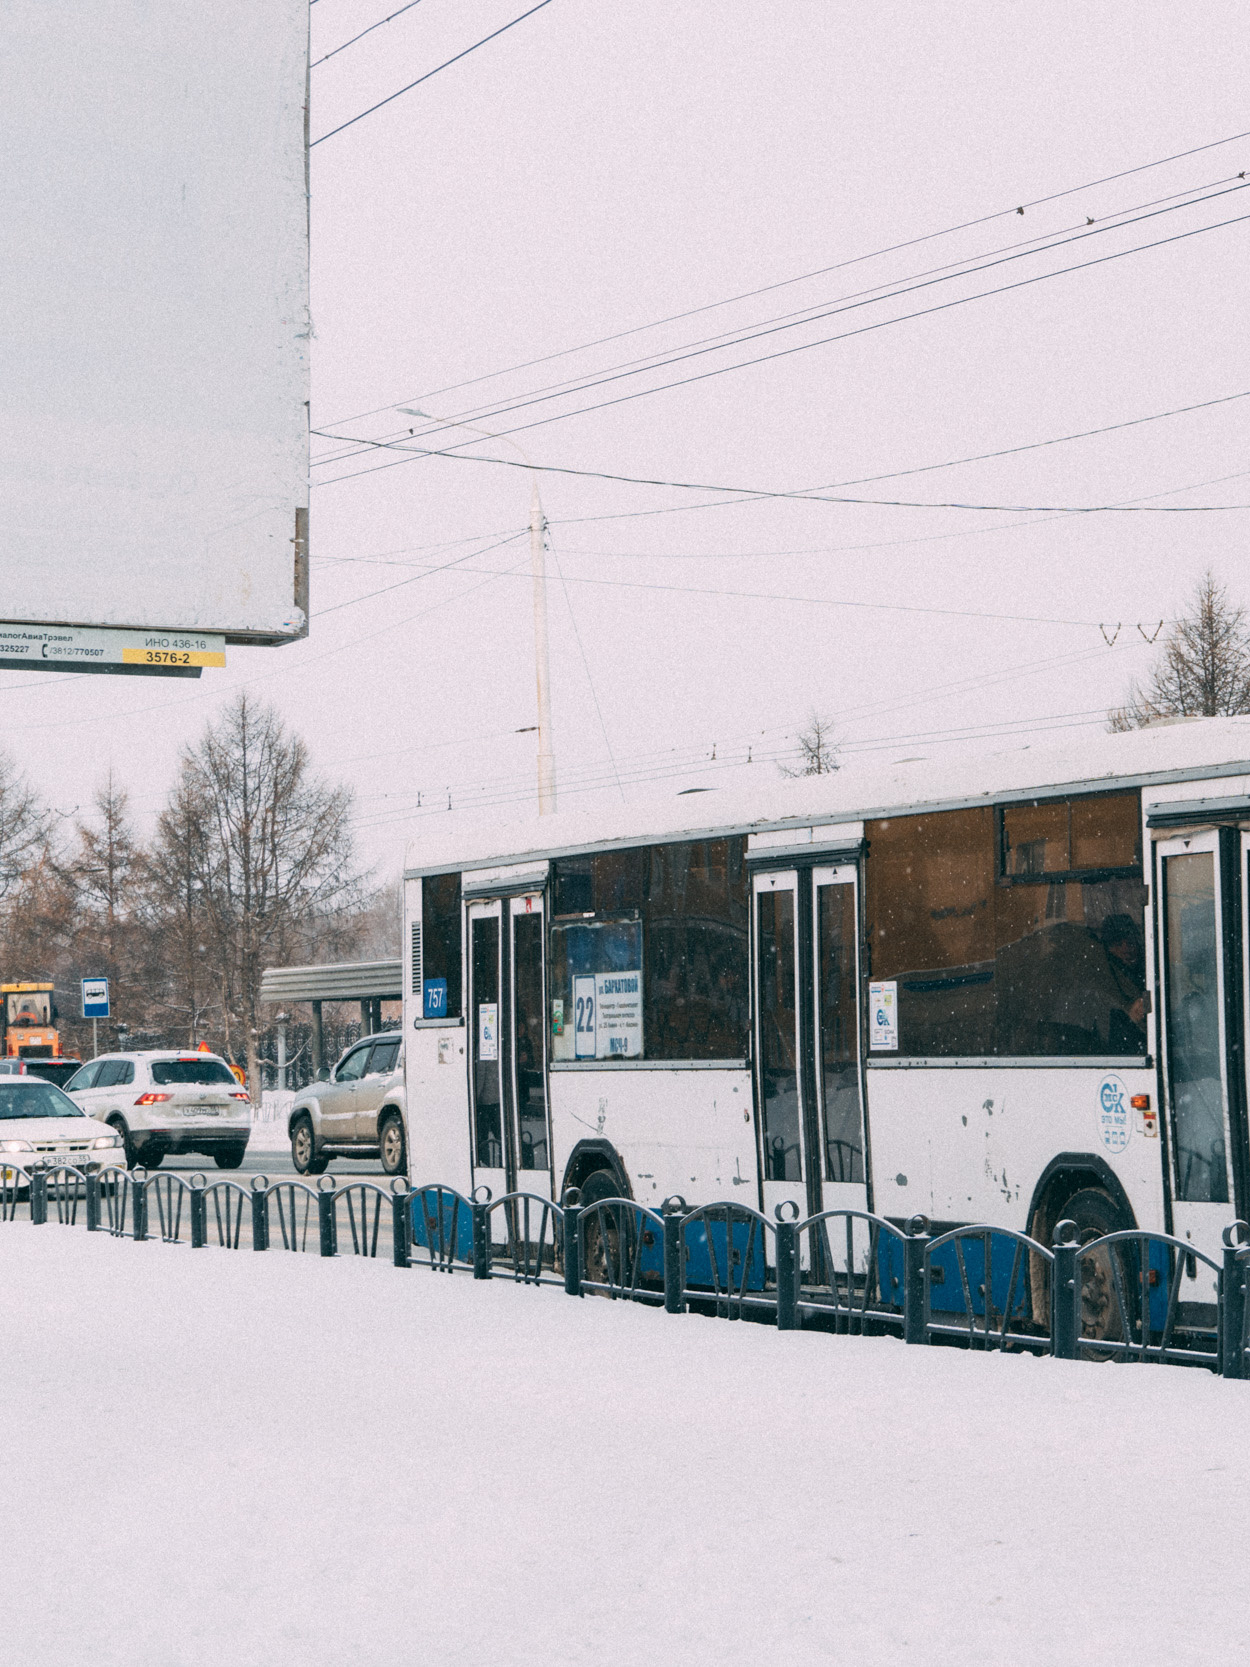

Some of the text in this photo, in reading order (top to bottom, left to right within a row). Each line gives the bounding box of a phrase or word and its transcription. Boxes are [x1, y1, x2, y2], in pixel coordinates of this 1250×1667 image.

[145, 637, 207, 650] ИНО 436-16
[146, 651, 190, 664] 3576-2
[427, 987, 443, 1009] 757
[576, 996, 594, 1033] 22
[609, 1037, 628, 1052] МСЧ-9
